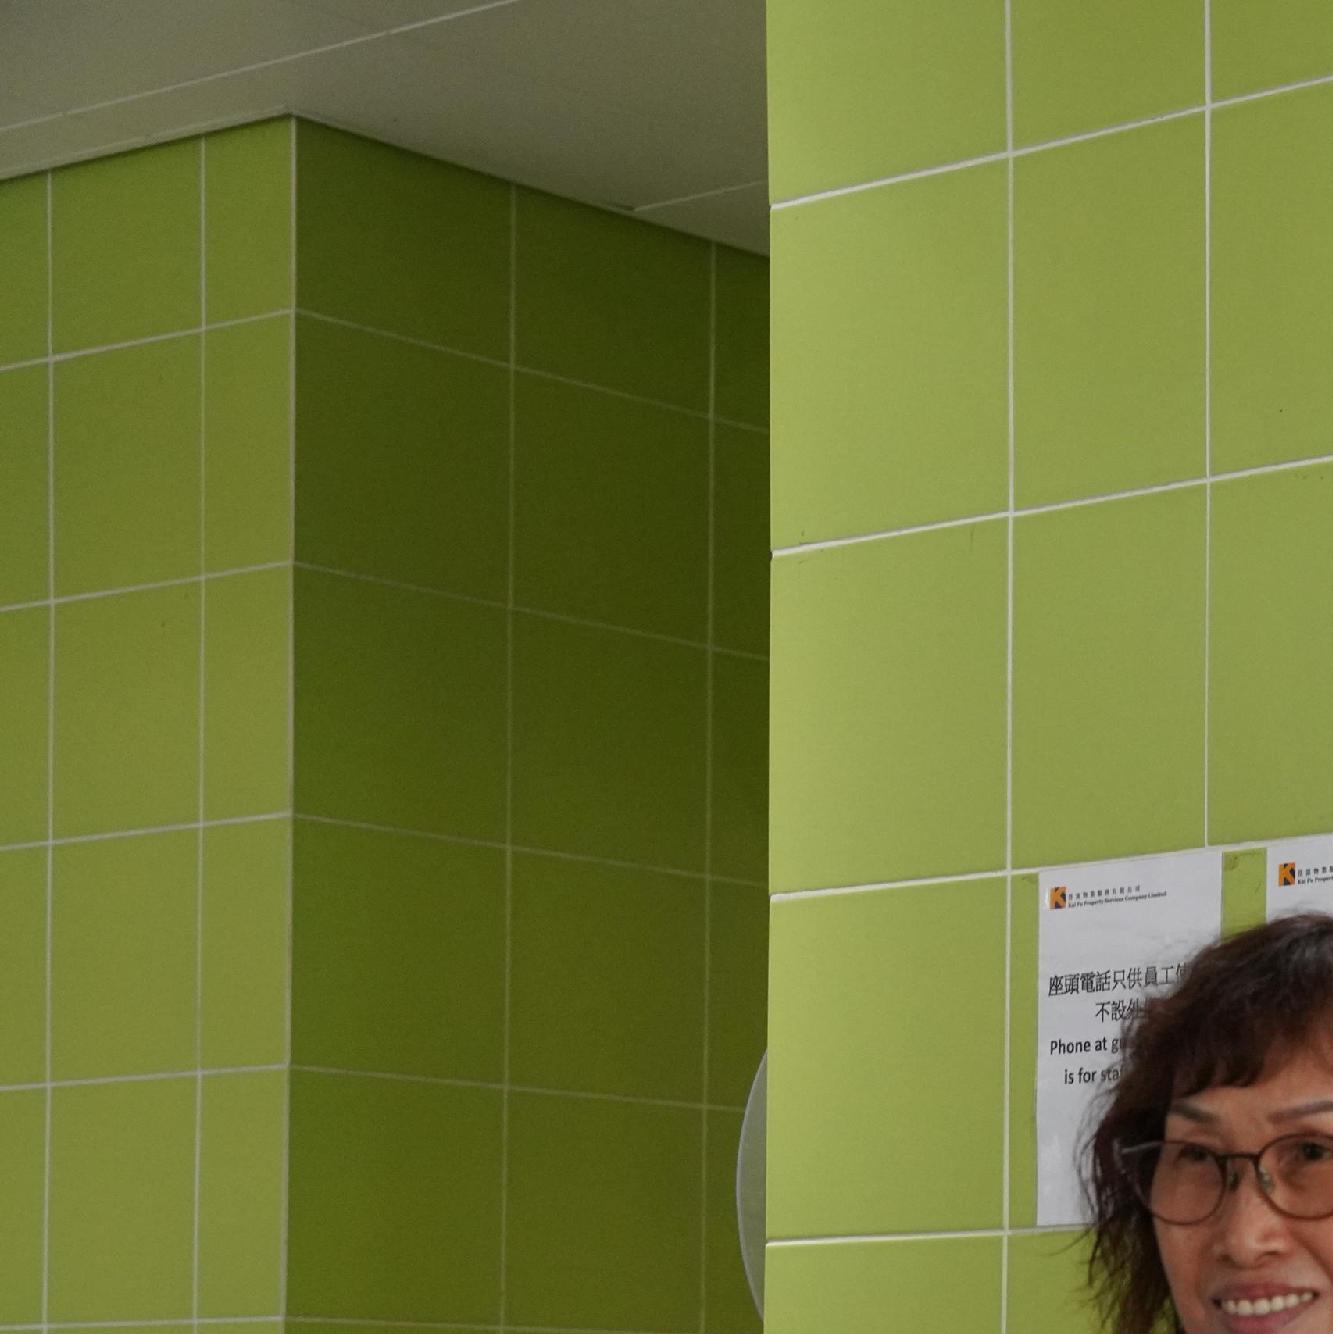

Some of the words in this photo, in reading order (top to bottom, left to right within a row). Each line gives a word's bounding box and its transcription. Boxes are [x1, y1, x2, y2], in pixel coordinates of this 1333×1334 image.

[1050, 1038, 1091, 1055] Phone
[1094, 1037, 1107, 1051] at
[1064, 1069, 1074, 1085] is
[1077, 1067, 1097, 1083] for
